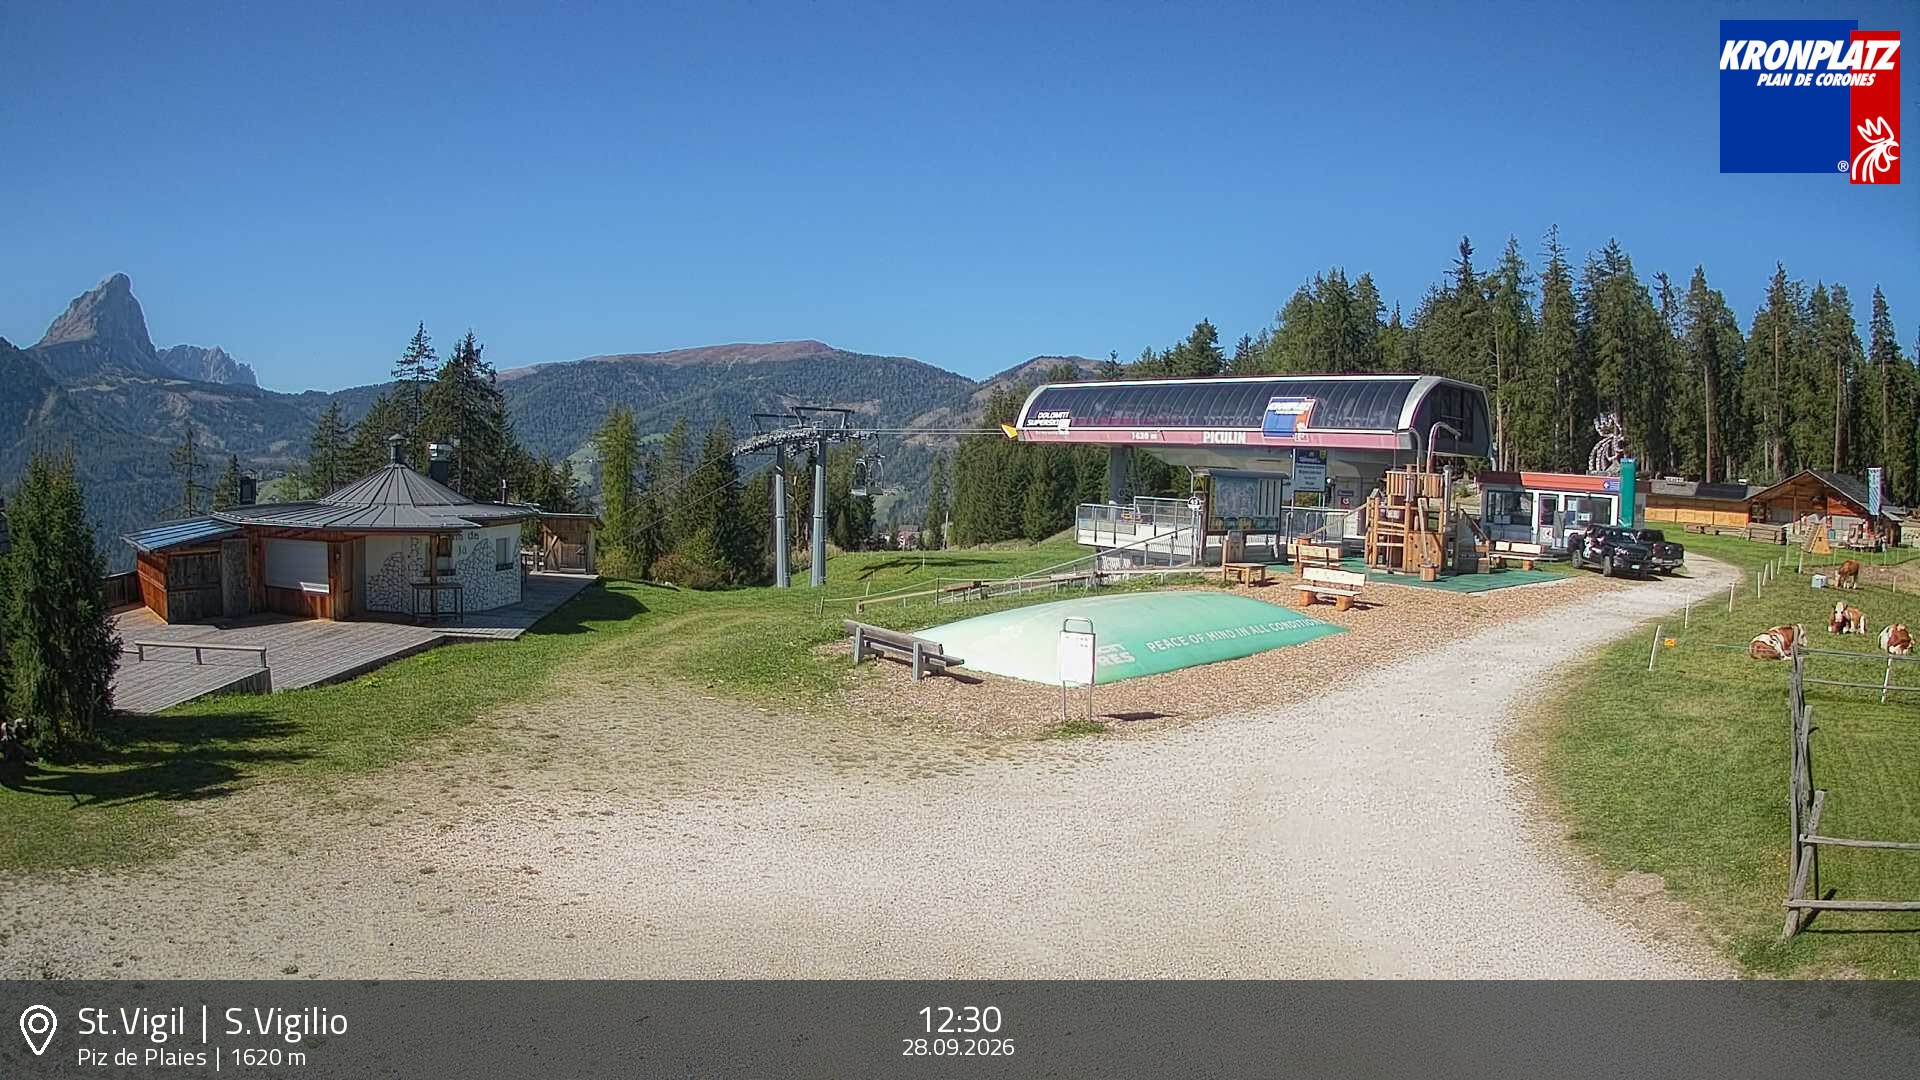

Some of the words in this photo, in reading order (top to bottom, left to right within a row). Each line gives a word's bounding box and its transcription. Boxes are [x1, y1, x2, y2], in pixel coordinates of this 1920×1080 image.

[1203, 431, 1246, 444] PICULIN
[1146, 635, 1189, 652] PEACE
[1188, 633, 1204, 645] OF
[1207, 628, 1236, 641] MIND
[1237, 626, 1250, 636] IN
[1250, 623, 1270, 635] ALL
